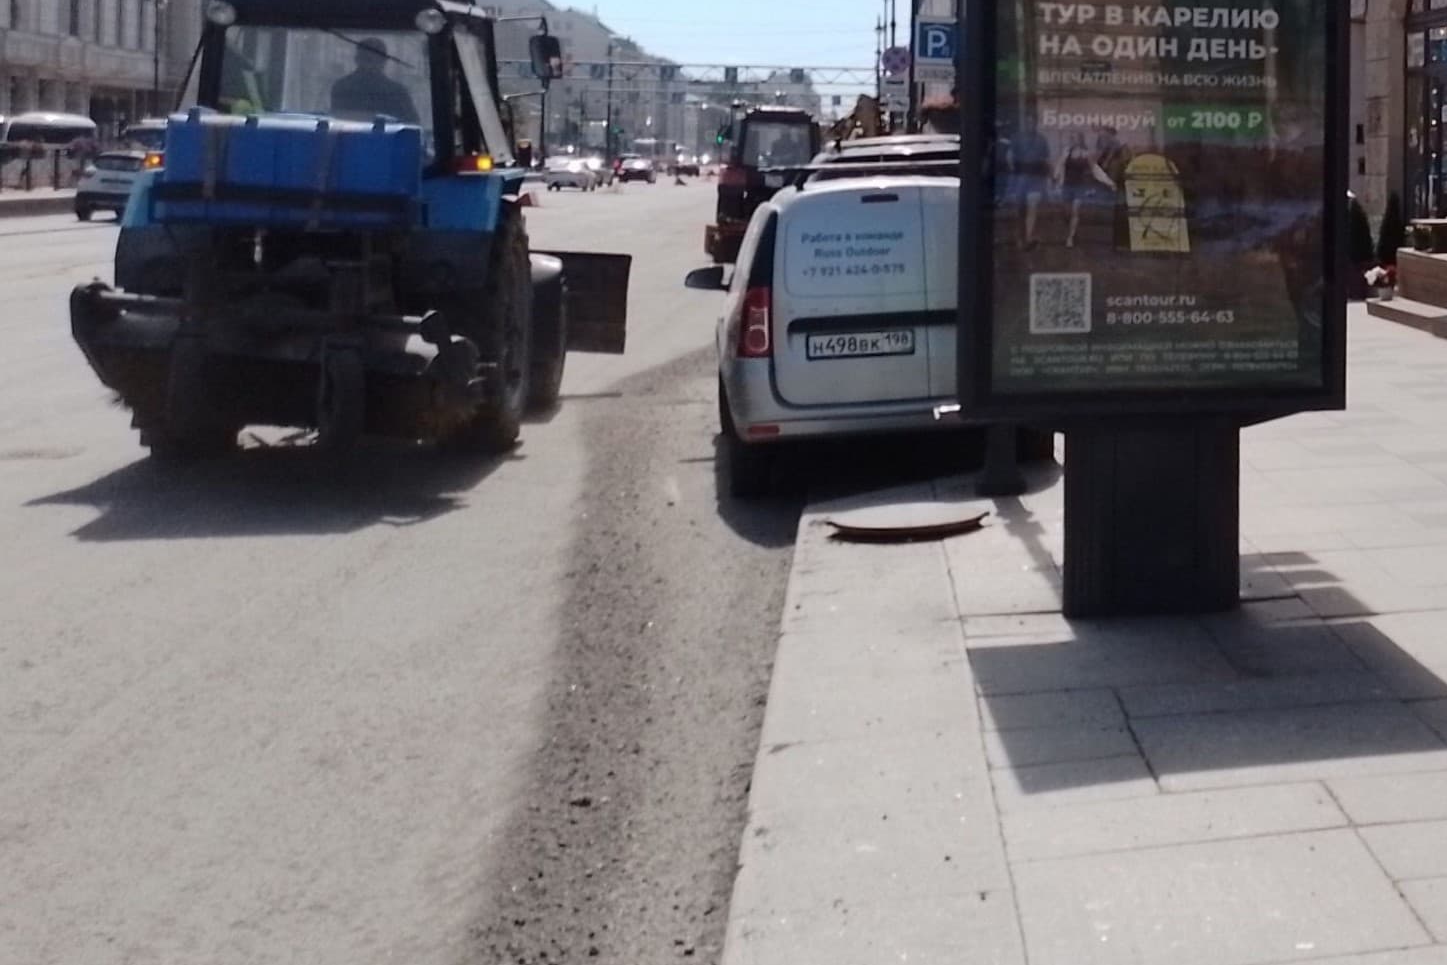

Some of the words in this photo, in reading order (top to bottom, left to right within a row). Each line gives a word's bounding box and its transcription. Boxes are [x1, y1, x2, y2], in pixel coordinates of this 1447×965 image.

[1038, 2, 1096, 25] ТУР
[1105, 6, 1124, 26] В
[1133, 6, 1280, 29] КАРЕЛИЮ
[1038, 35, 1083, 56] НА
[1091, 37, 1179, 60] ОДИН
[1158, 73, 1181, 85] НА
[1183, 74, 1219, 86] ВСЮ
[1221, 74, 1278, 87] ЖИЗНЬ
[1042, 110, 1156, 129] Бронируй
[1167, 116, 1187, 129] от
[1190, 110, 1242, 129] 2100
[1105, 294, 1197, 307] scantour.ru
